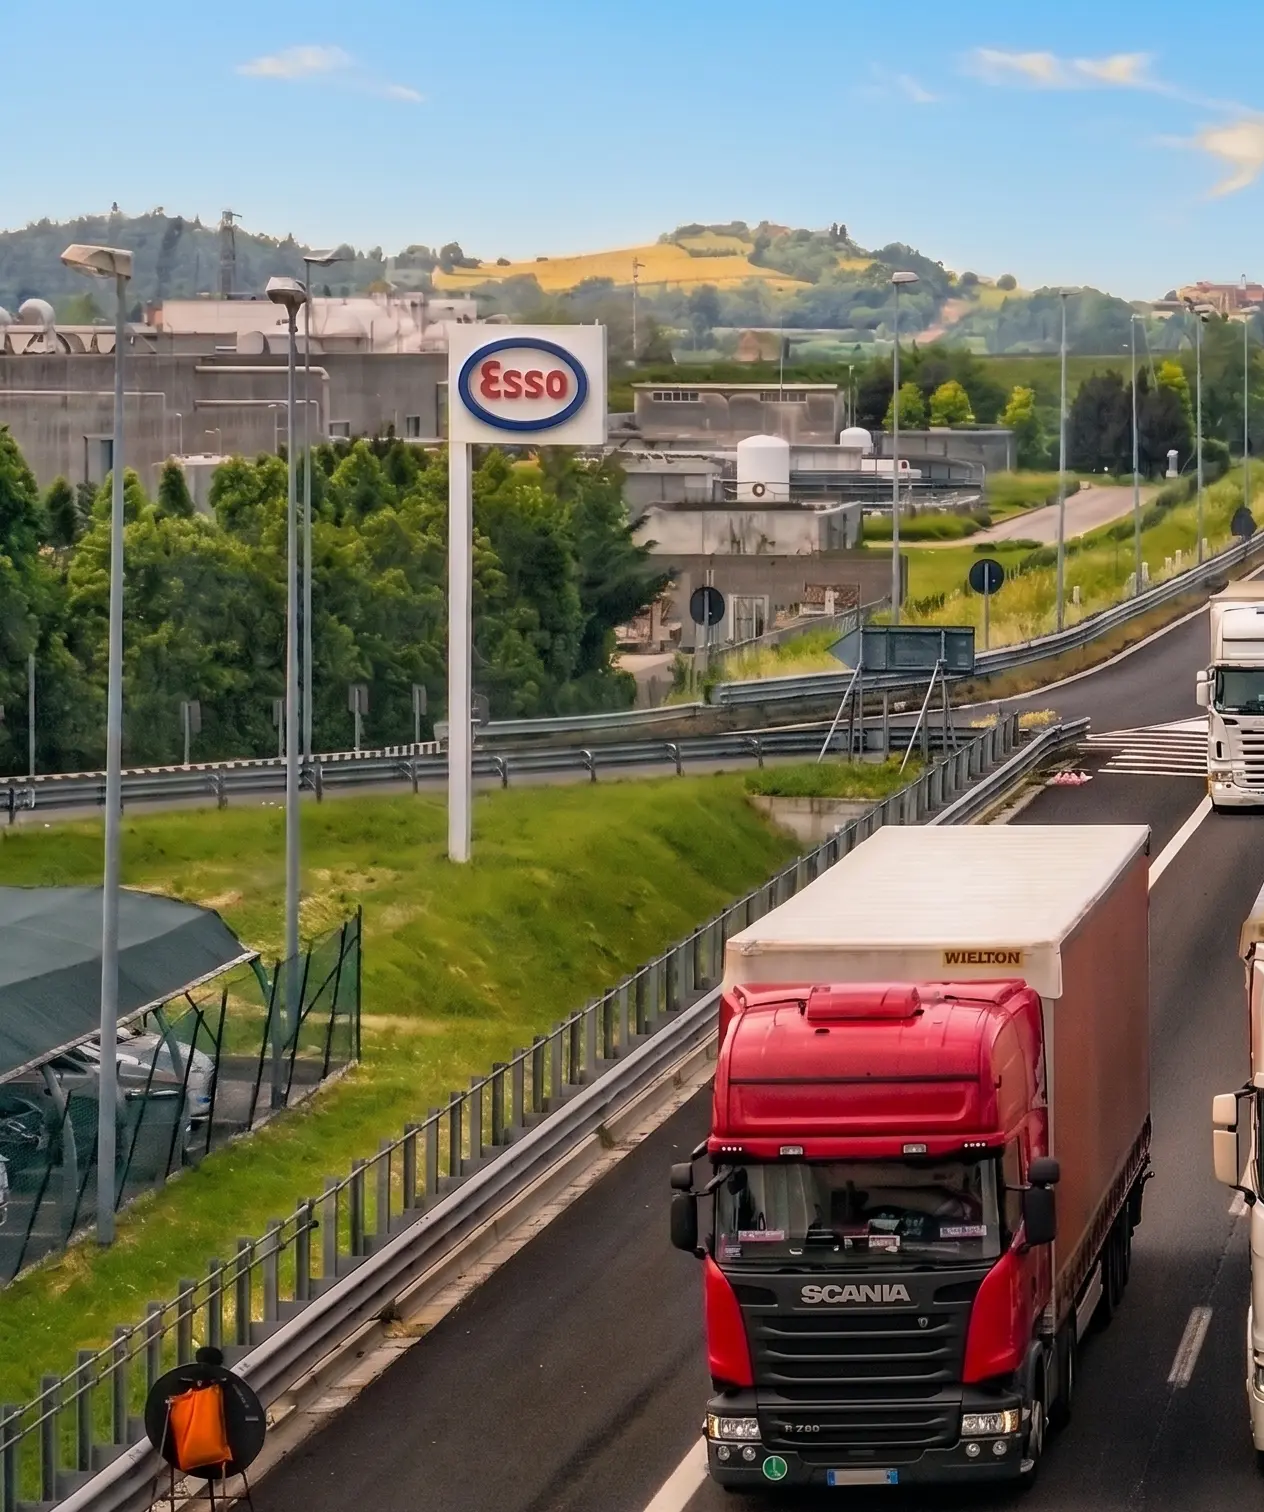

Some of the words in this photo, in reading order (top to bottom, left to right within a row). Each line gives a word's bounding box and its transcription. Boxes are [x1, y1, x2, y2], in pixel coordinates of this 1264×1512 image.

[480, 360, 568, 400] Esso
[944, 951, 1021, 965] WIELTON
[801, 1284, 912, 1304] SCANIA
